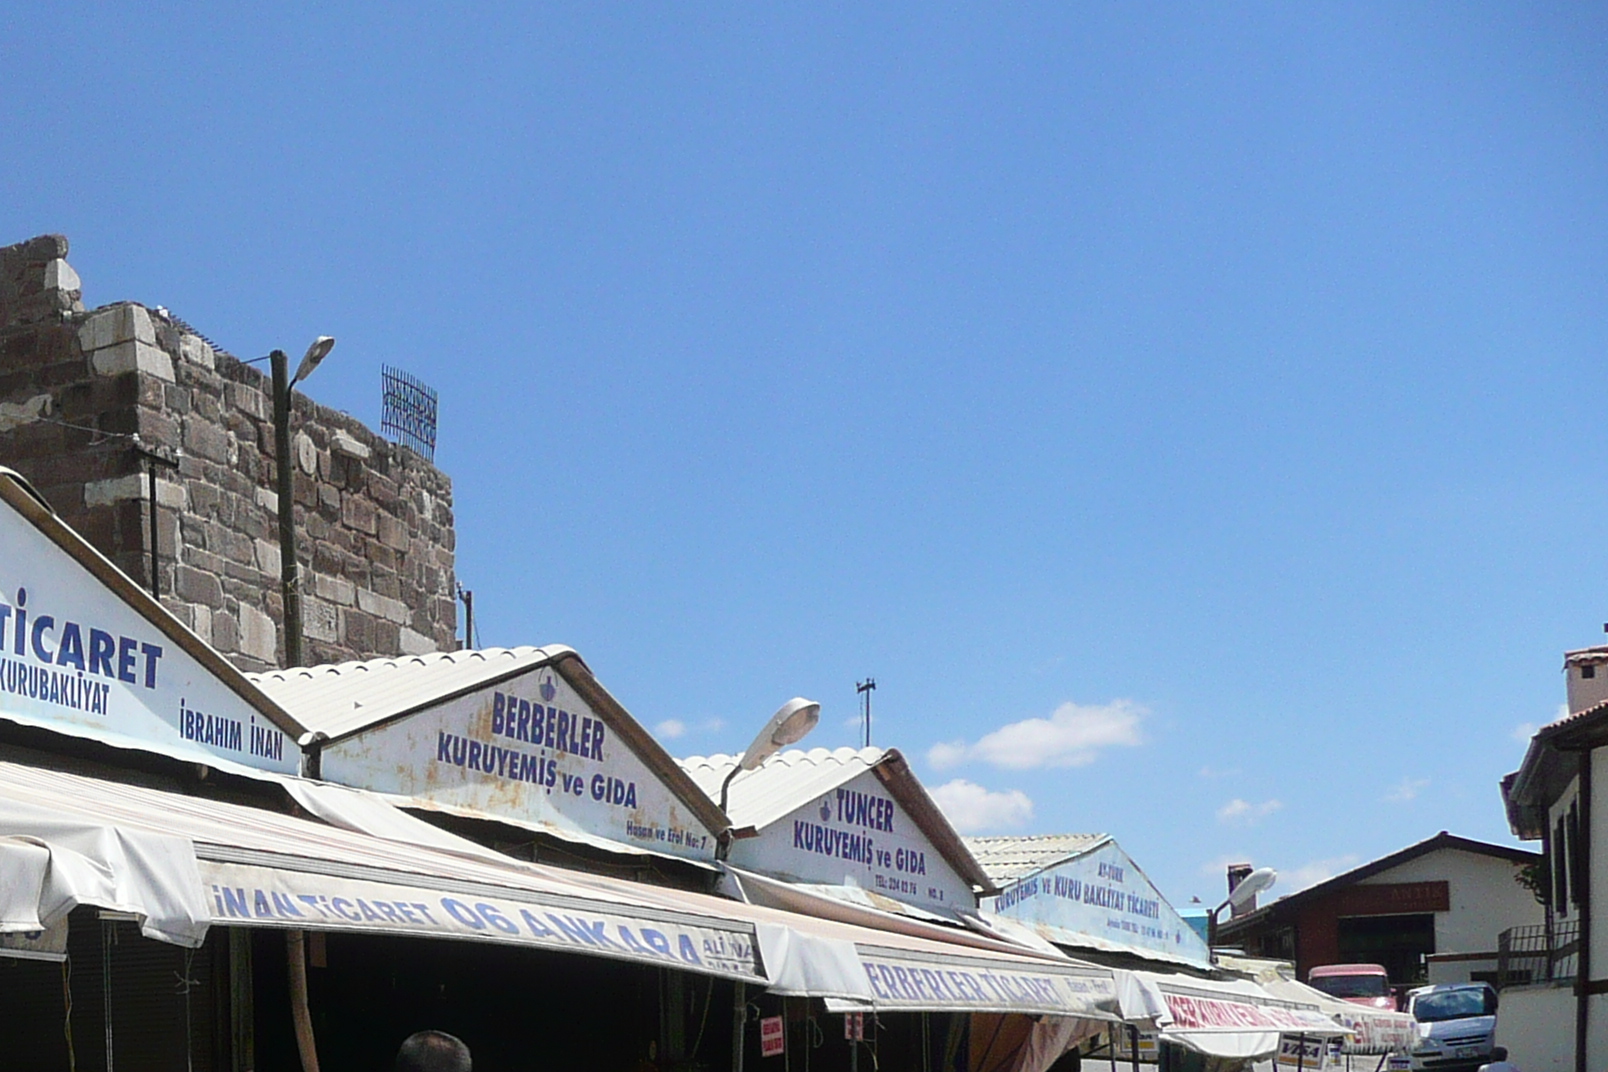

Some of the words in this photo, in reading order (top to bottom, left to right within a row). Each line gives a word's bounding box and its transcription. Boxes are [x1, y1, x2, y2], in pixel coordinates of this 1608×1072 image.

[180, 699, 242, 752] İBRAHIM
[250, 715, 283, 761] İNAN
[493, 691, 604, 762] BERBERLER
[437, 732, 556, 795] KURUYEMİŞ
[562, 773, 584, 796] ve
[591, 773, 638, 810] GIDA
[626, 820, 653, 837] Hasan
[655, 829, 665, 841] ve
[668, 828, 684, 845] Erol
[836, 788, 894, 833] TUNCER
[794, 820, 873, 871] KURUYEMİŞ
[876, 849, 891, 869] ve
[896, 847, 926, 876] GIDA
[212, 885, 306, 918] İNAN
[297, 894, 439, 926] TİCARET
[441, 897, 520, 935] 06
[519, 909, 702, 965] ANKARA
[1041, 877, 1052, 896] VE
[1054, 875, 1082, 902] KURU
[1083, 883, 1124, 912] BAKLİYAT
[1127, 891, 1160, 920] TİCARETİ
[703, 936, 725, 956] ALİ
